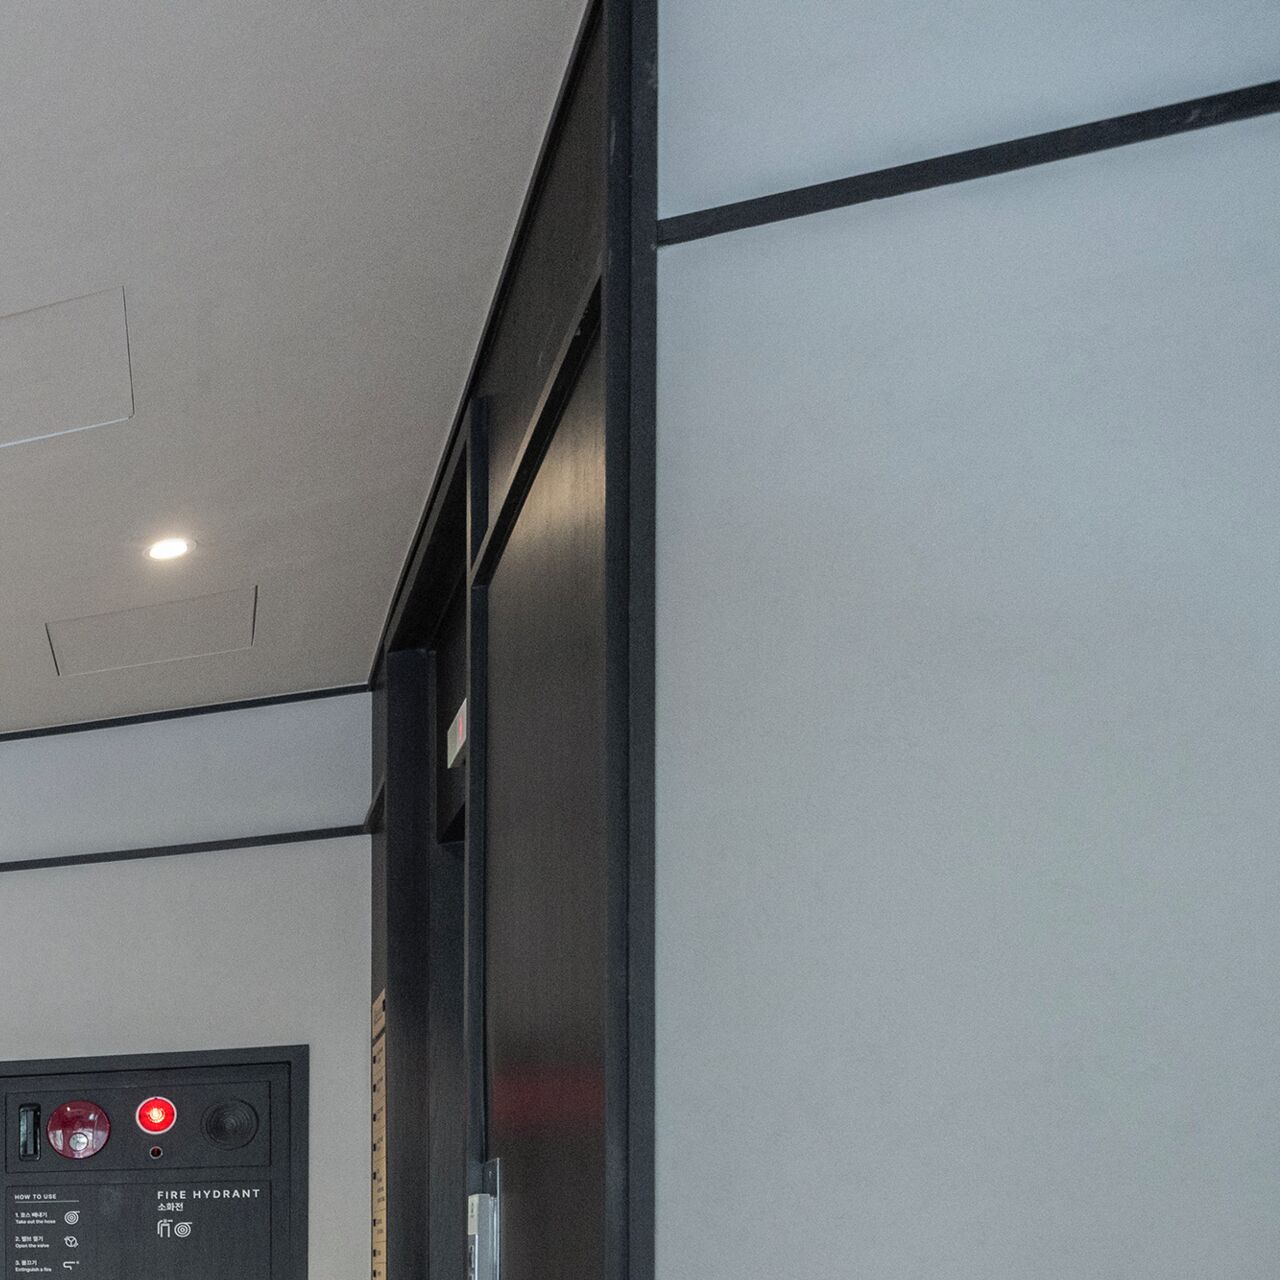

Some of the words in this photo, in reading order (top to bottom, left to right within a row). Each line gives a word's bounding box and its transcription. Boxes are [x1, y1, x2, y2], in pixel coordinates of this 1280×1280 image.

[157, 1190, 186, 1200] FIRE
[192, 1189, 260, 1199] HYDRANT
[157, 1202, 184, 1212] 소화전
